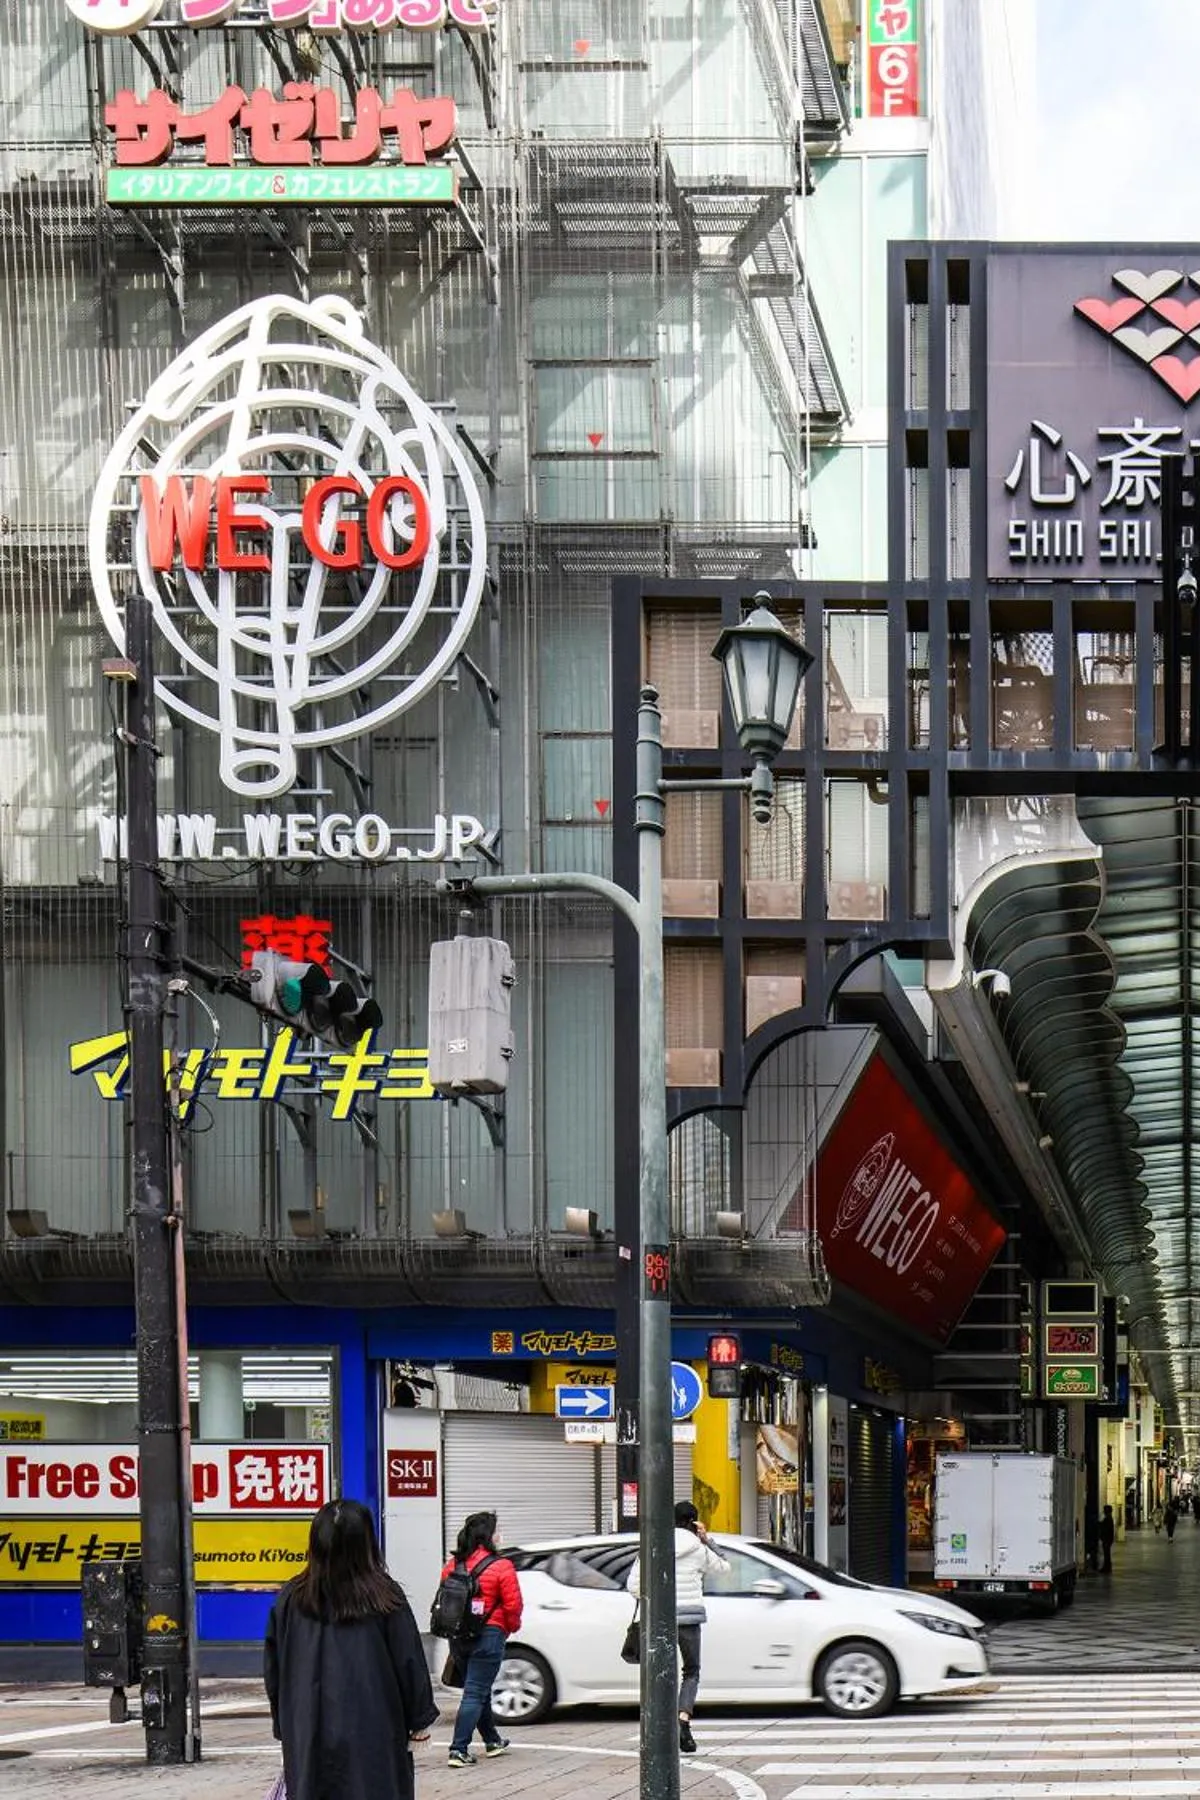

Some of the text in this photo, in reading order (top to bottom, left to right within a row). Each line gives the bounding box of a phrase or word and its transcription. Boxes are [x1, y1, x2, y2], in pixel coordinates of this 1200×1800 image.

[105, 82, 458, 166] サイゼリヤ
[70, 1026, 440, 1120] マツモトキヨ
[856, 1157, 940, 1275] WEGO
[6, 1456, 219, 1502] Free Sp
[234, 1454, 318, 1502] 免税
[193, 1549, 309, 1563] sumoto KiYos
